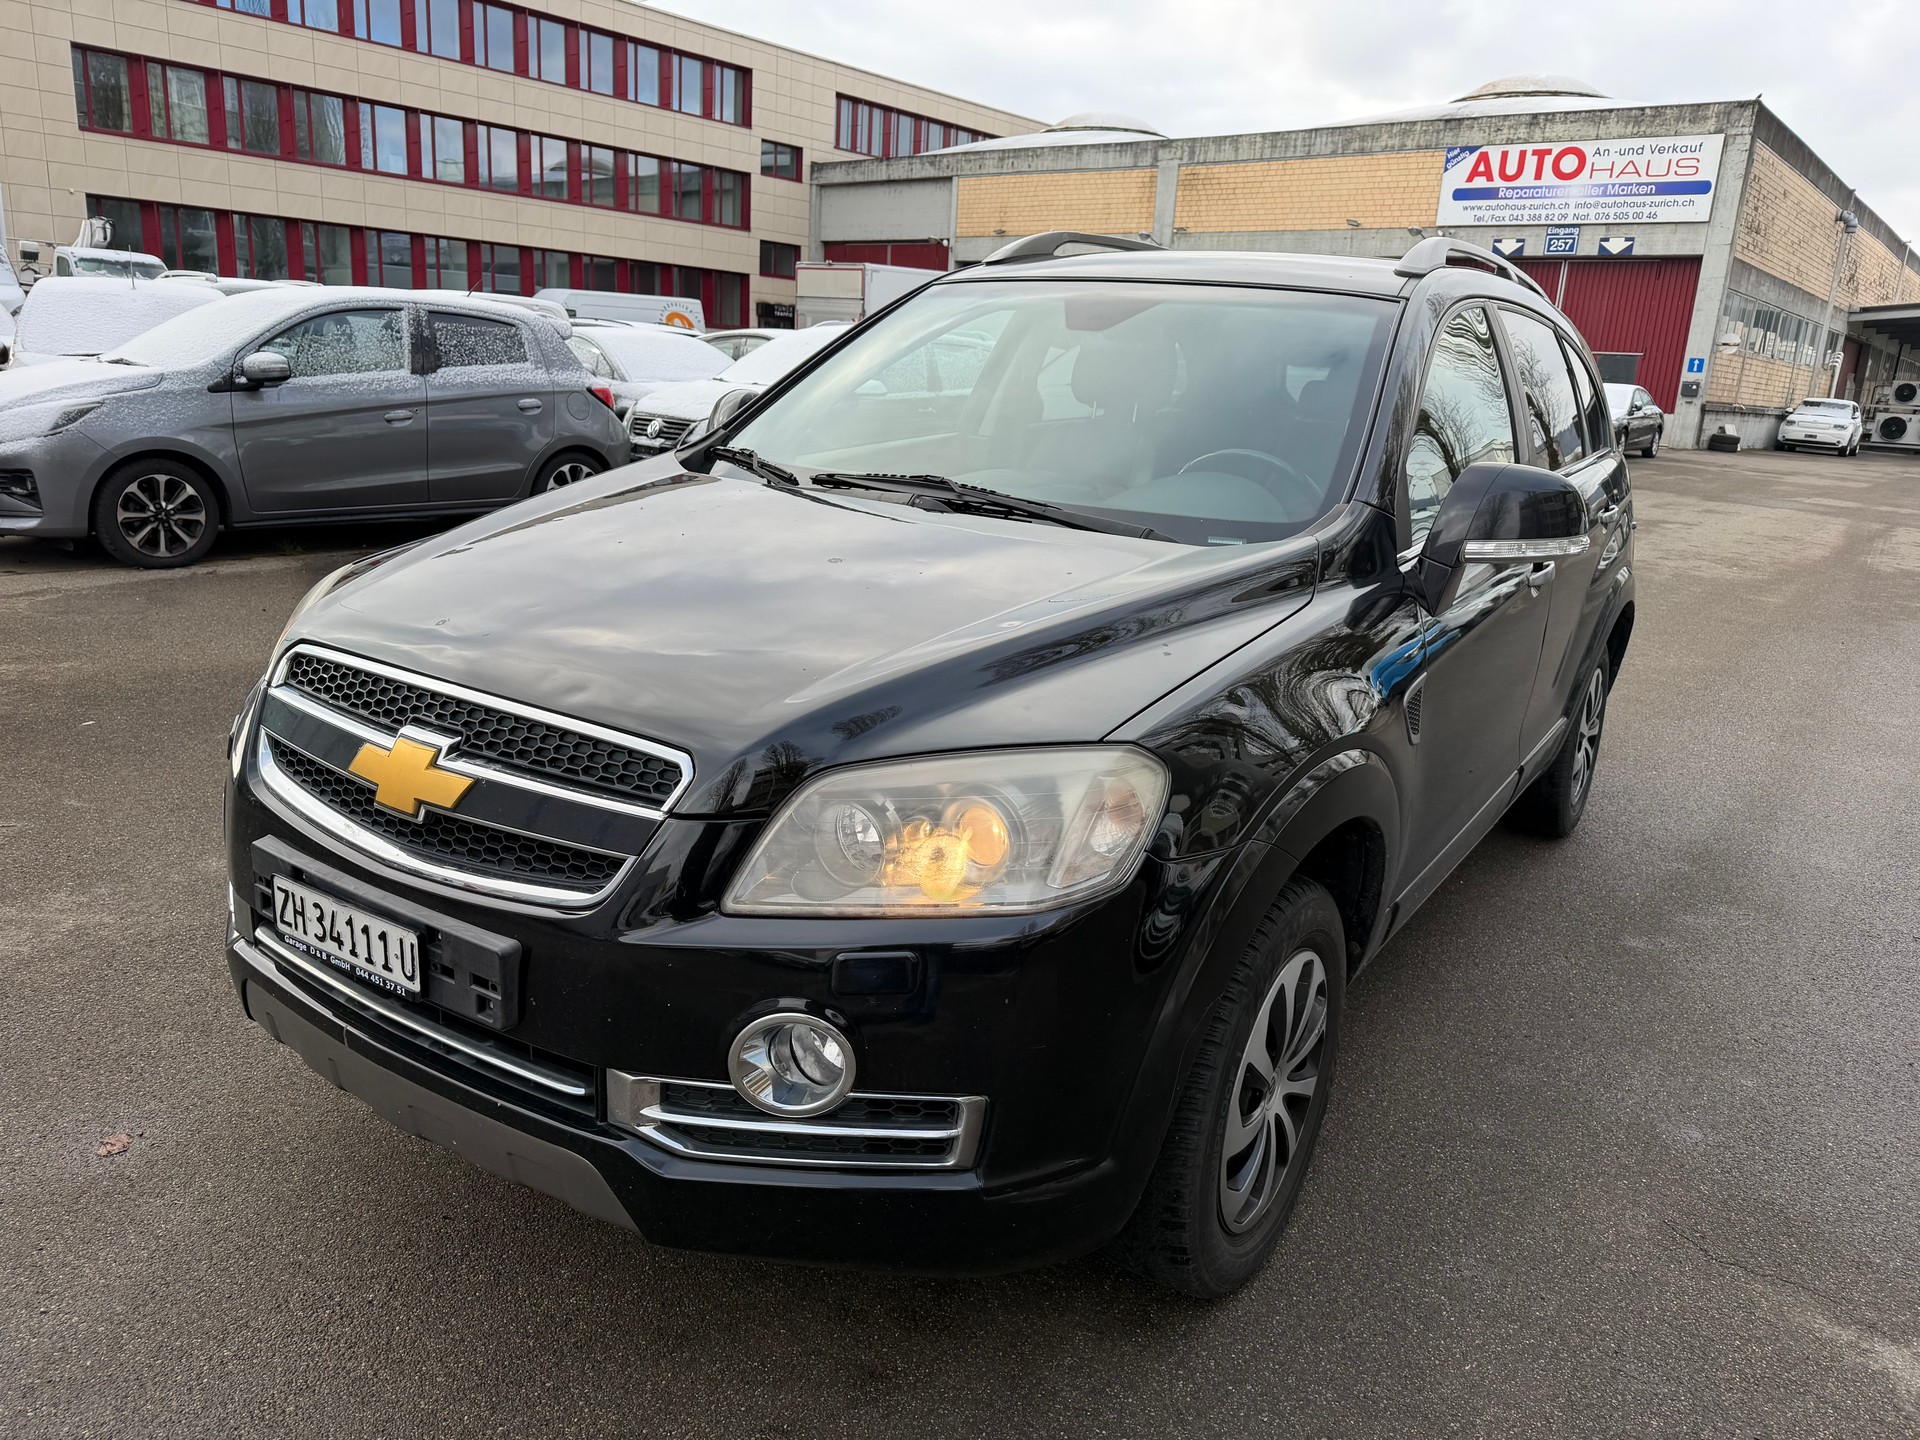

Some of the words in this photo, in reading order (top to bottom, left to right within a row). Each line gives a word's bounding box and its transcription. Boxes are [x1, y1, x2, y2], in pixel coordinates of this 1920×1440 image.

[1592, 147, 1610, 157] An
[1649, 142, 1704, 154] Verkauf
[1465, 146, 1587, 183] AUTO
[1589, 157, 1700, 179] HAUS
[1574, 185, 1604, 196] aller
[1606, 183, 1656, 195] Marken
[1462, 201, 1570, 211] www.autohaus-zurich.ch
[1574, 198, 1695, 209] info@autohaus-zurich.ch
[1473, 214, 1506, 223] Tel./Fax
[1508, 213, 1524, 222] 043
[1526, 213, 1542, 222] 388
[1544, 213, 1555, 221] 82
[1557, 212, 1569, 221] 09
[1572, 212, 1592, 221] Nat.
[1594, 211, 1610, 220] 076
[1612, 211, 1630, 220] 505
[1632, 211, 1644, 220] 00
[1646, 211, 1658, 219] 46
[1547, 226, 1580, 235] Eingang
[1549, 239, 1573, 251] 257
[276, 885, 308, 937] ZH
[312, 901, 393, 973] 34111
[399, 936, 417, 982] U
[284, 935, 307, 952] Garage
[309, 947, 315, 955] D
[316, 950, 321, 958] &
[322, 952, 327, 960] B
[330, 955, 351, 971] GmbH
[355, 967, 369, 980] 044
[370, 973, 384, 987] 451
[385, 980, 395, 991] 37
[396, 985, 406, 997] 51
